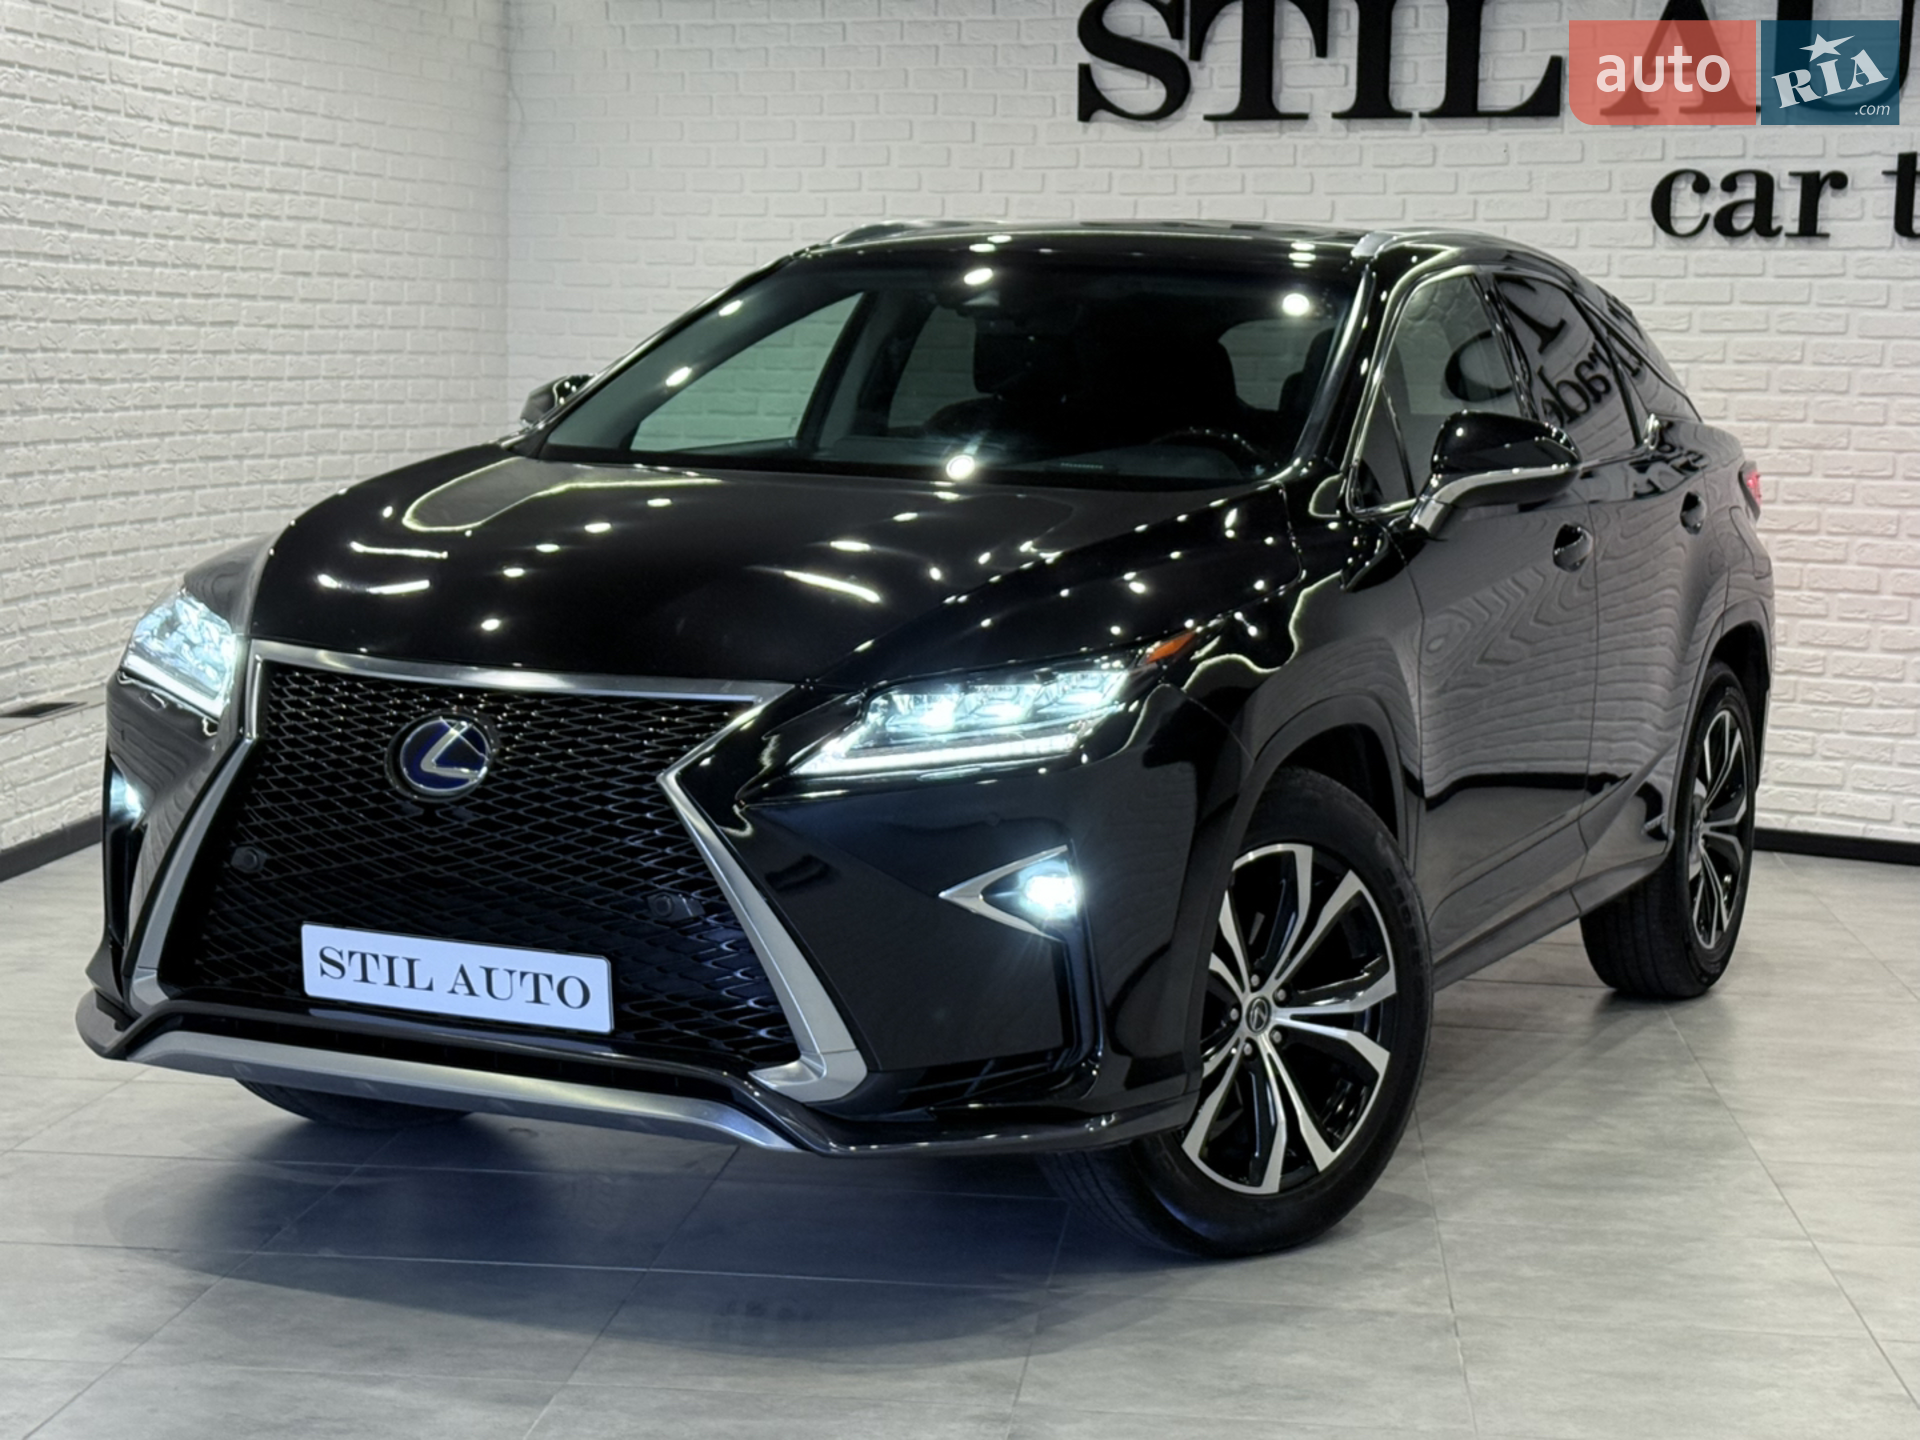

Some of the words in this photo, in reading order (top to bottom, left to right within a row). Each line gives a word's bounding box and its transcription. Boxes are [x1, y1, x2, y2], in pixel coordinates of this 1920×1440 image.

[1077, 0, 1563, 122] STIL
[1651, 168, 1849, 238] car
[318, 946, 434, 992] STIL
[446, 963, 591, 1010] AUTO
